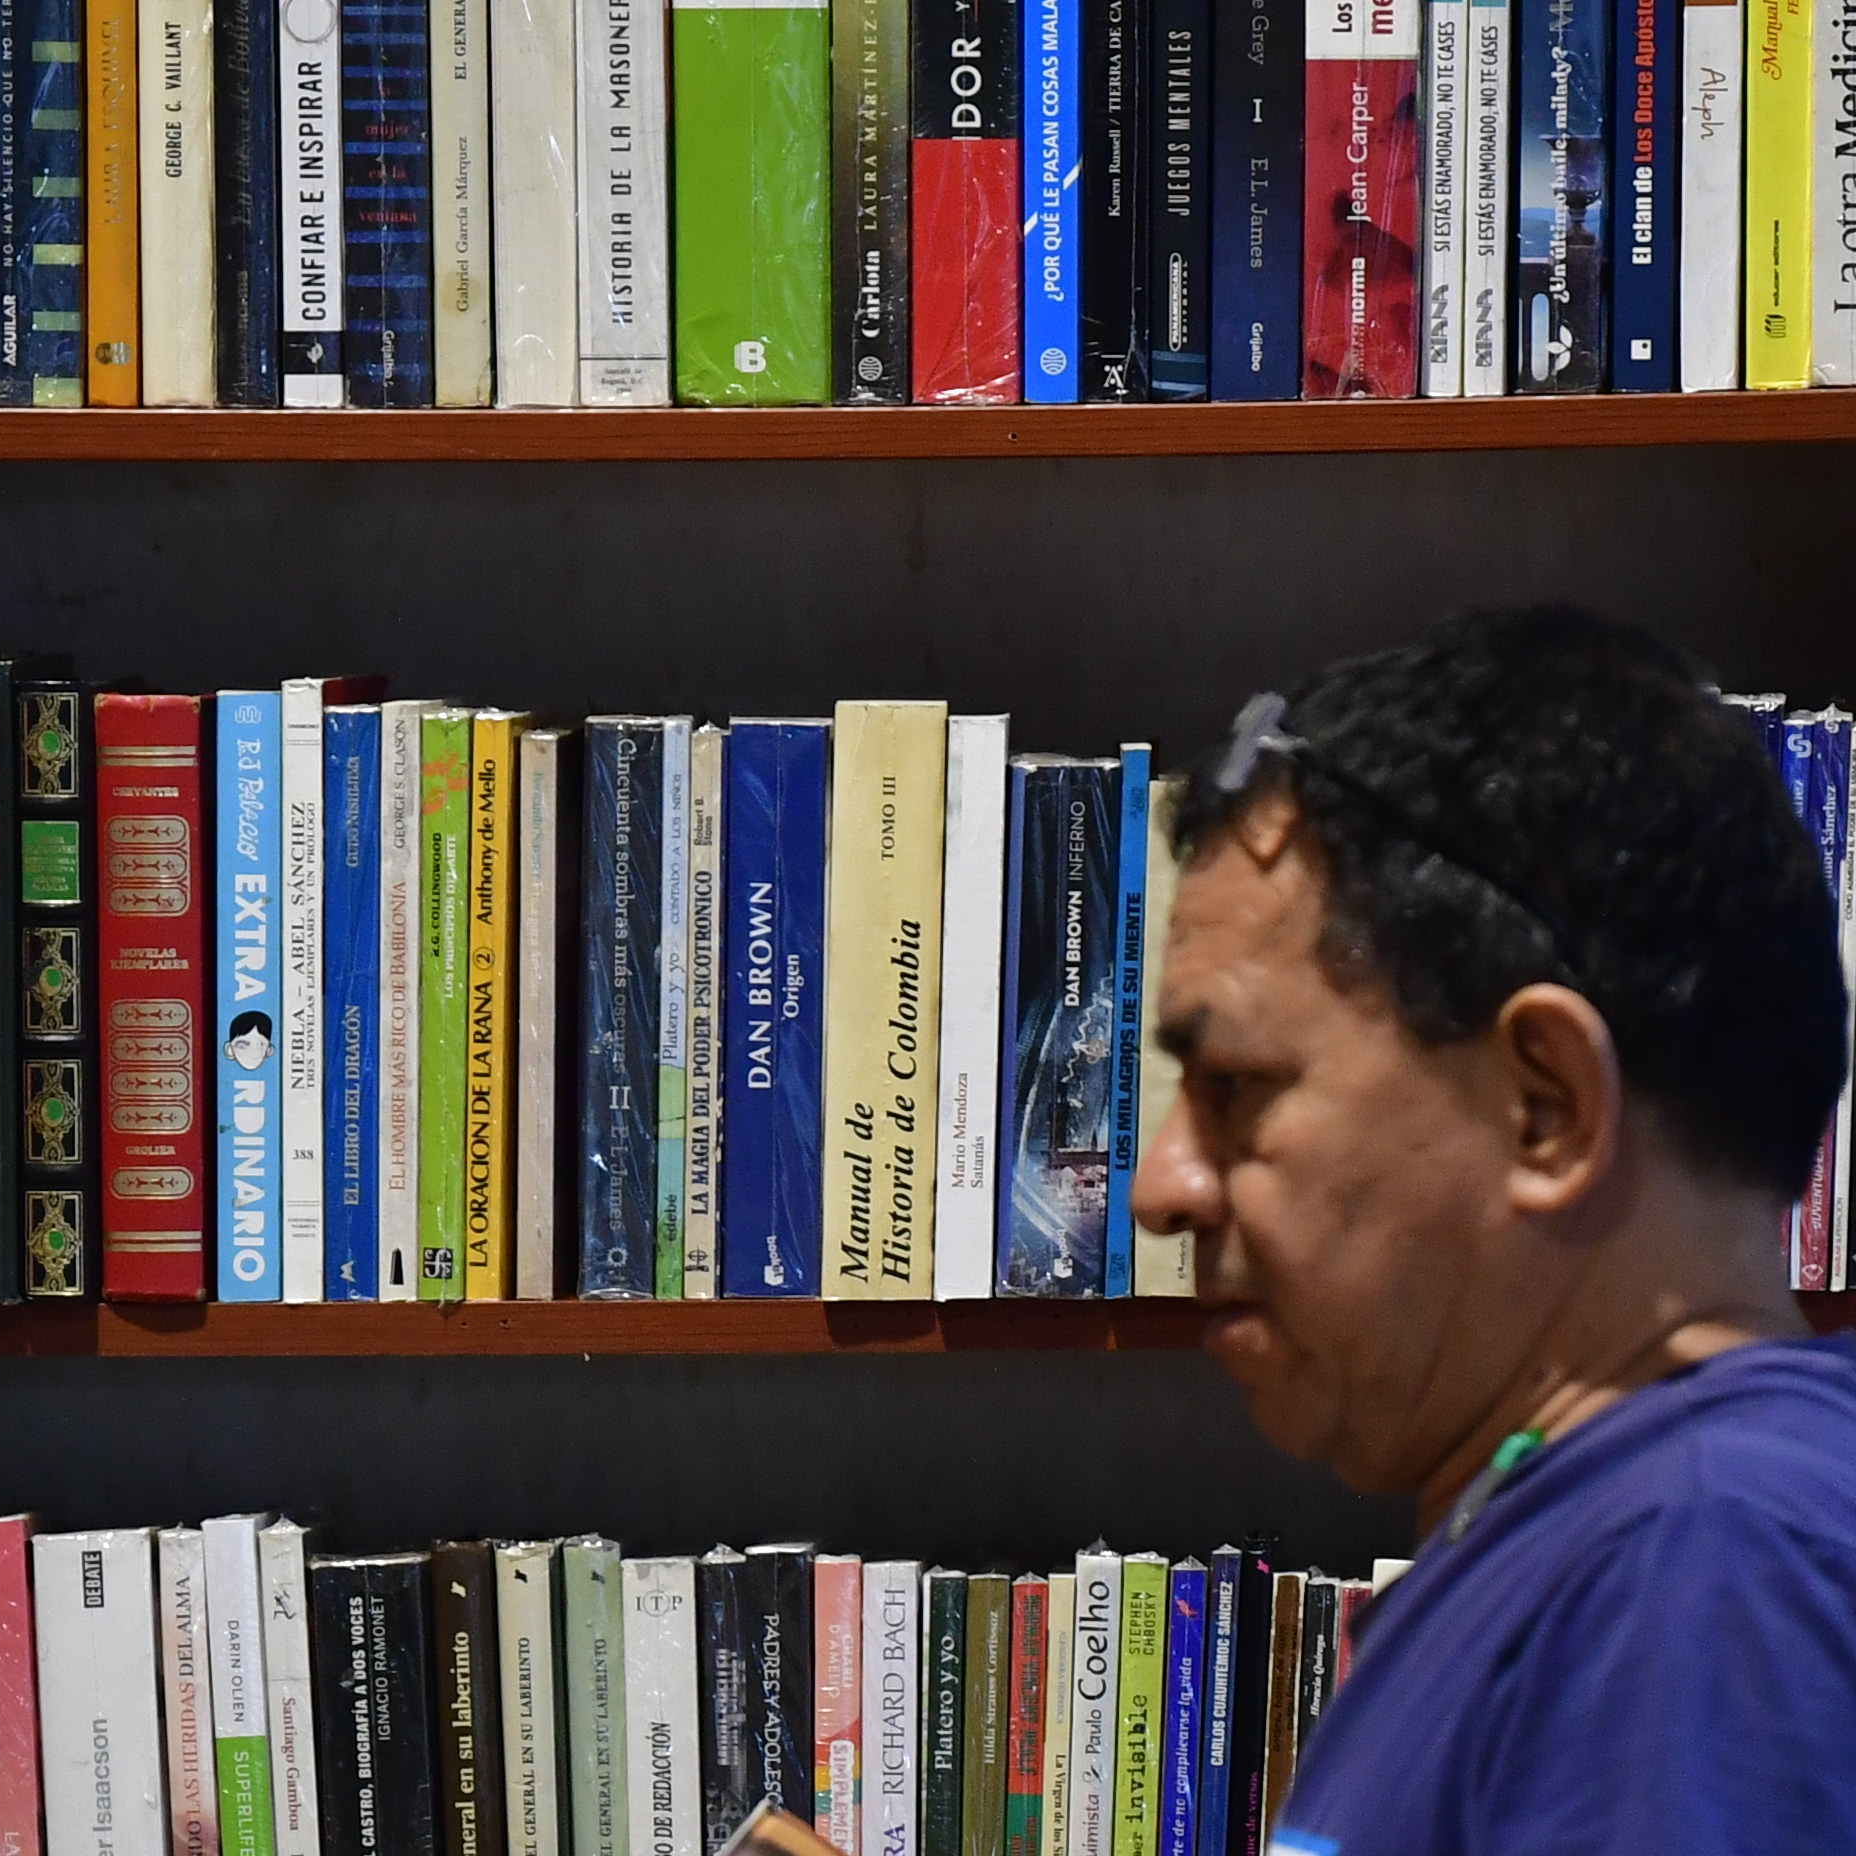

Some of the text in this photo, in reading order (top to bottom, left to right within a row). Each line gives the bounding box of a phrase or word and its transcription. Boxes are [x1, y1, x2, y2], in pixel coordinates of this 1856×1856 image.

[166, 21, 182, 90] VAILLANT
[1691, 67, 1727, 139] Aleph
[166, 122, 182, 178] GEORGE
[1040, 56, 1063, 301] ¿POR QUÉ LE PASAN COSAS
[1168, 30, 1191, 216] JUEGOS MENTALES
[1347, 82, 1373, 221] Jean Carper
[1632, 72, 1653, 264] El clan de Los Doce
[297, 61, 327, 321] CONFIAR E INSPIRAR
[455, 136, 471, 312] Gabriel García Márquez
[610, 126, 633, 323] HISTORIA DE LA
[881, 776, 896, 861] TOMO III
[289, 802, 306, 1090] NIEBLA ABEL SÁNCHEZ
[748, 881, 773, 1089] DAN BROWN
[783, 953, 803, 1018] Origen
[470, 759, 497, 1267] LA ORACION DE LA RANA Anthony de Mello
[882, 918, 922, 1283] Historia de Colombia
[952, 1072, 968, 1188] Mario Mendoza
[840, 1102, 875, 1283] Manual de
[971, 1135, 986, 1188] Satanás
[84, 1553, 103, 1605] DEBATE
[1129, 1592, 1142, 1655] STEPHEN
[1142, 1592, 1157, 1656] CHBOSKY
[450, 1631, 473, 1727] laberinto
[883, 1589, 905, 1796] RICHARD BACH
[1078, 1580, 1110, 1701] Coelho
[89, 1718, 114, 1832] Isaacson
[457, 1733, 473, 1759] su
[457, 1765, 475, 1793] en
[1086, 1709, 1103, 1755] Paulo
[1124, 1694, 1149, 1823] invisible
